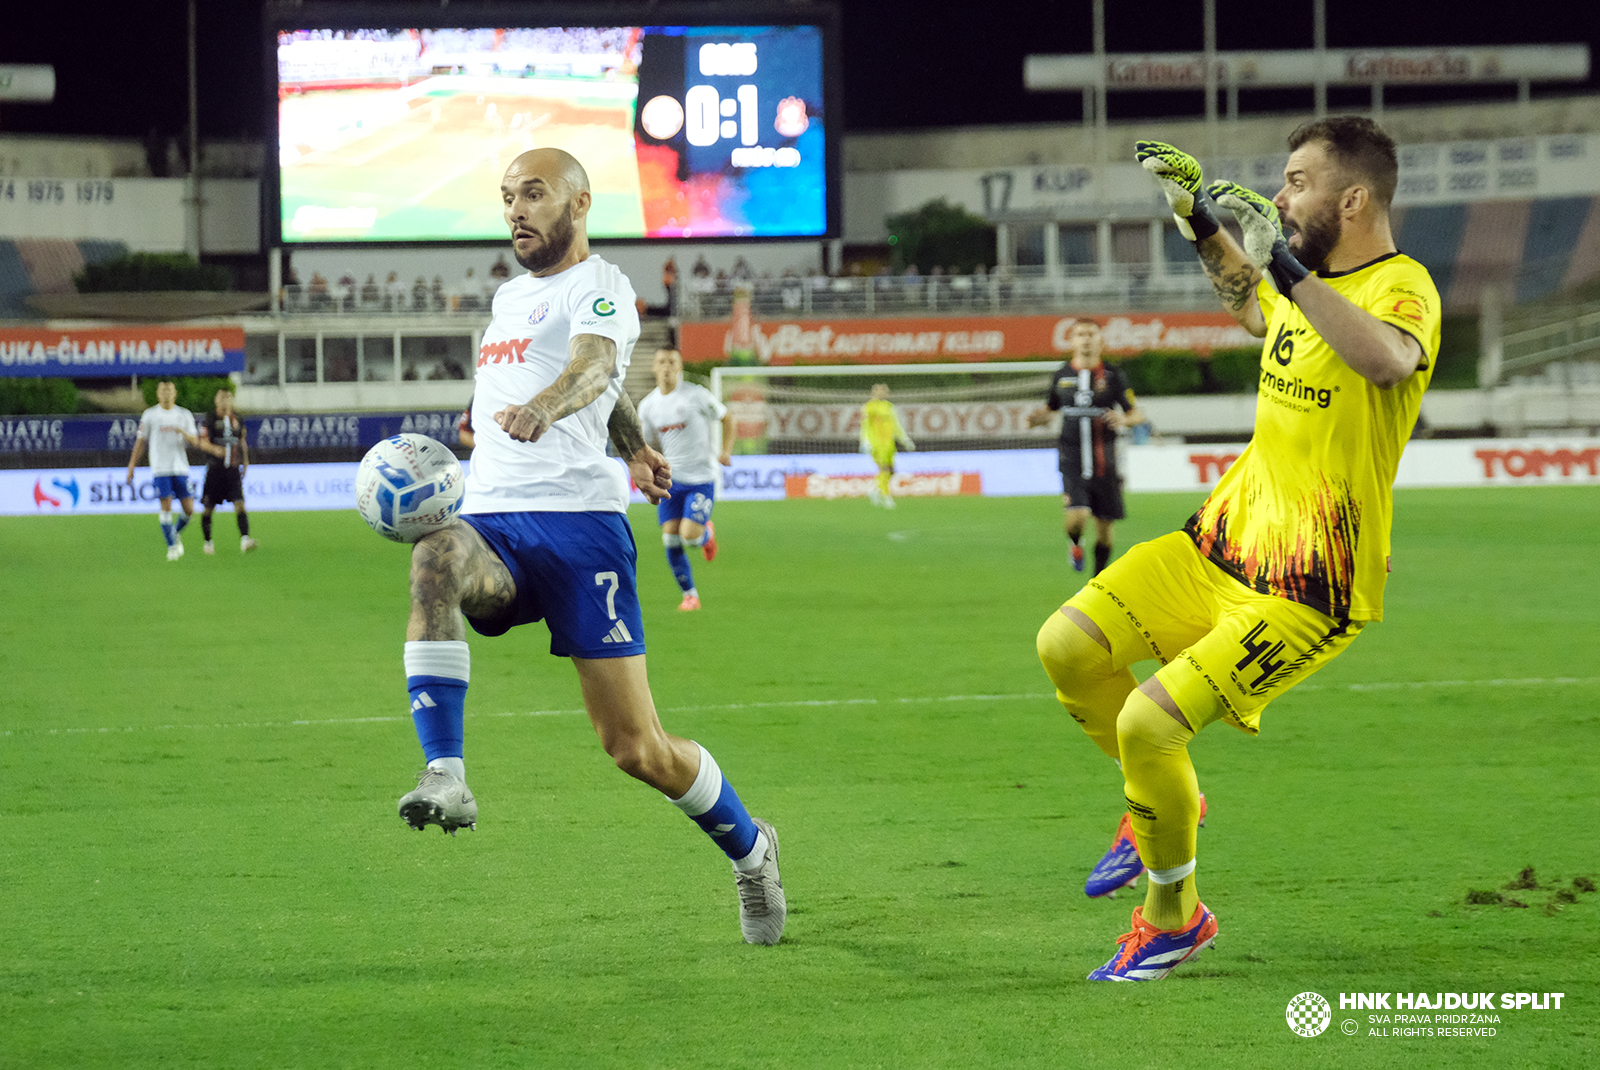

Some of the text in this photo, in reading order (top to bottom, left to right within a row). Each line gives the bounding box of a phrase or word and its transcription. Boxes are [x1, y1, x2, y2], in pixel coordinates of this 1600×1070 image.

[685, 84, 758, 147] 0:1
[119, 338, 225, 363] HAJDUKA
[943, 330, 1004, 354] KLUB
[258, 416, 360, 438] ADRIATIC
[248, 480, 308, 497] KLIMA
[595, 571, 619, 620] 7
[1187, 656, 1203, 672] FCG
[1235, 619, 1286, 690] 44
